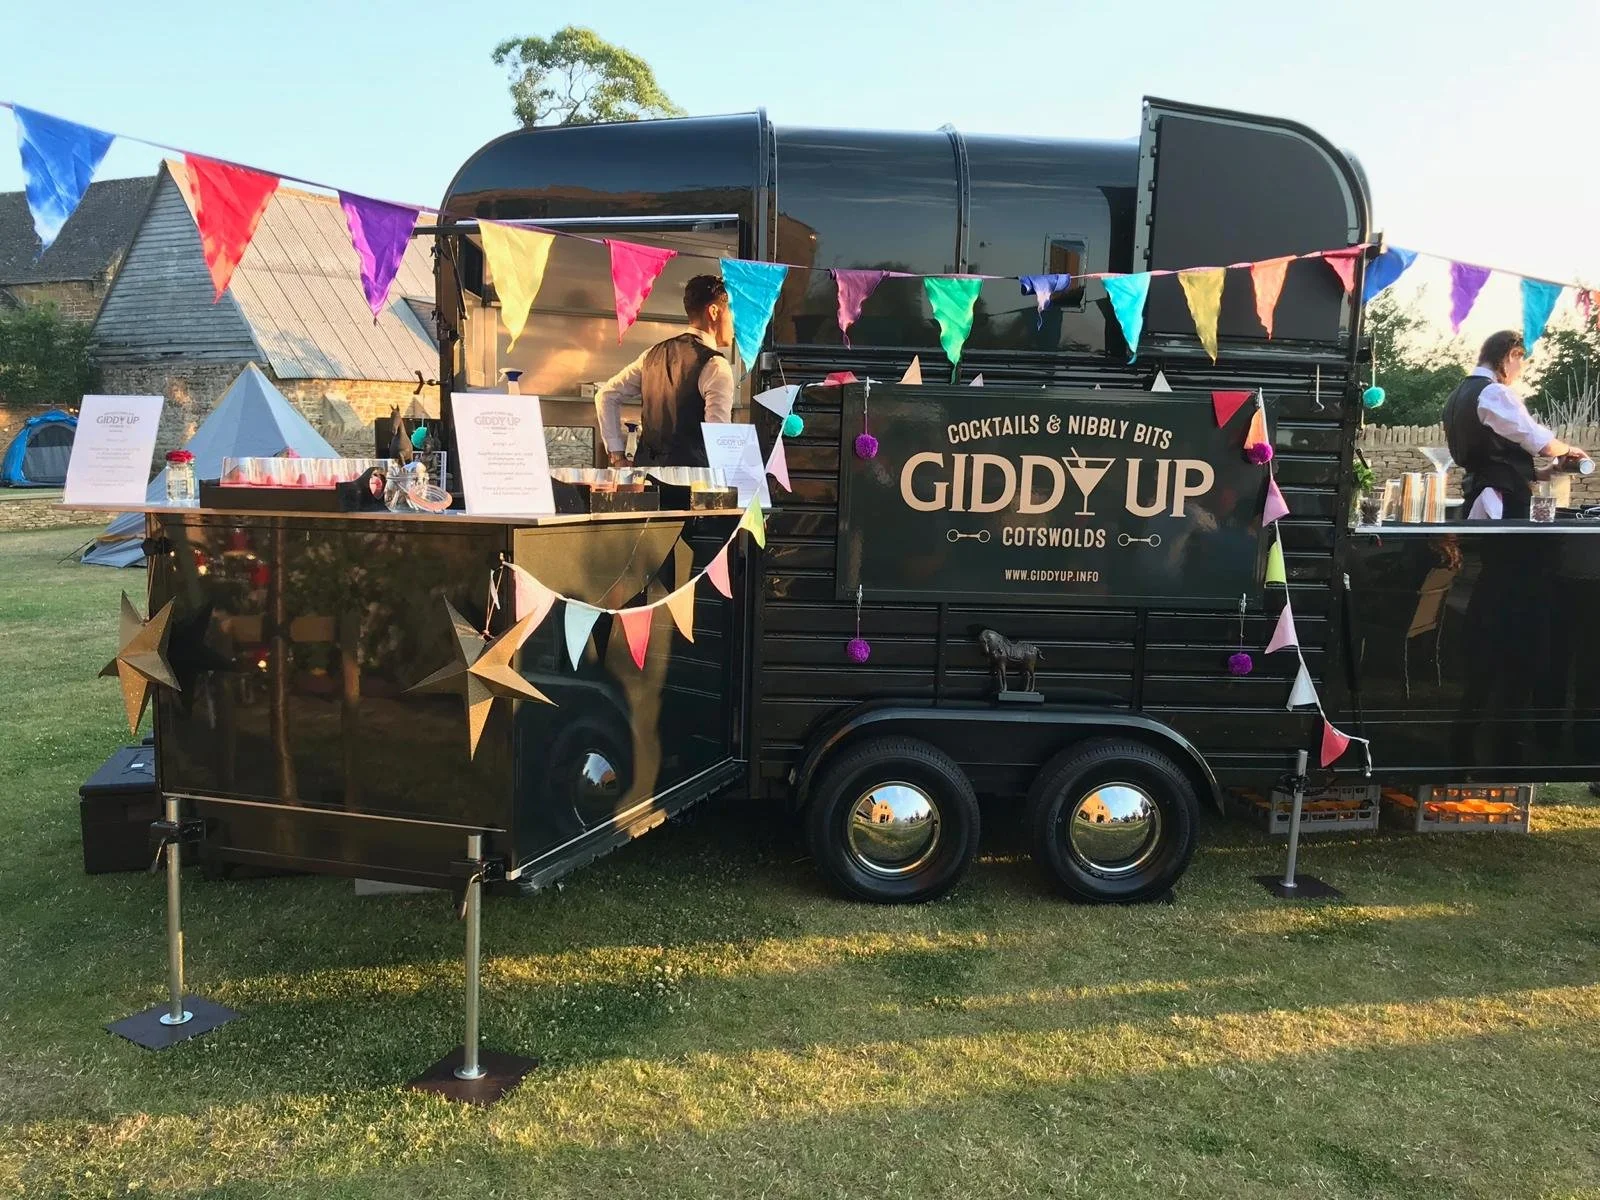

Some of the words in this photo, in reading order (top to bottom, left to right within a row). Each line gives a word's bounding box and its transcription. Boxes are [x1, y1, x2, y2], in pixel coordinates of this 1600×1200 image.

[126, 415, 140, 425] UP
[947, 414, 1040, 444] COCKTAILS
[1046, 414, 1062, 435] &
[1067, 414, 1130, 440] NIBBLY
[1133, 423, 1173, 450] BITS
[900, 448, 1117, 516] GIDDY
[1125, 457, 1215, 518] UP
[1002, 526, 1106, 549] COTSWOLDS
[1005, 569, 1099, 583] WWW.GIDDYUP.INFO
